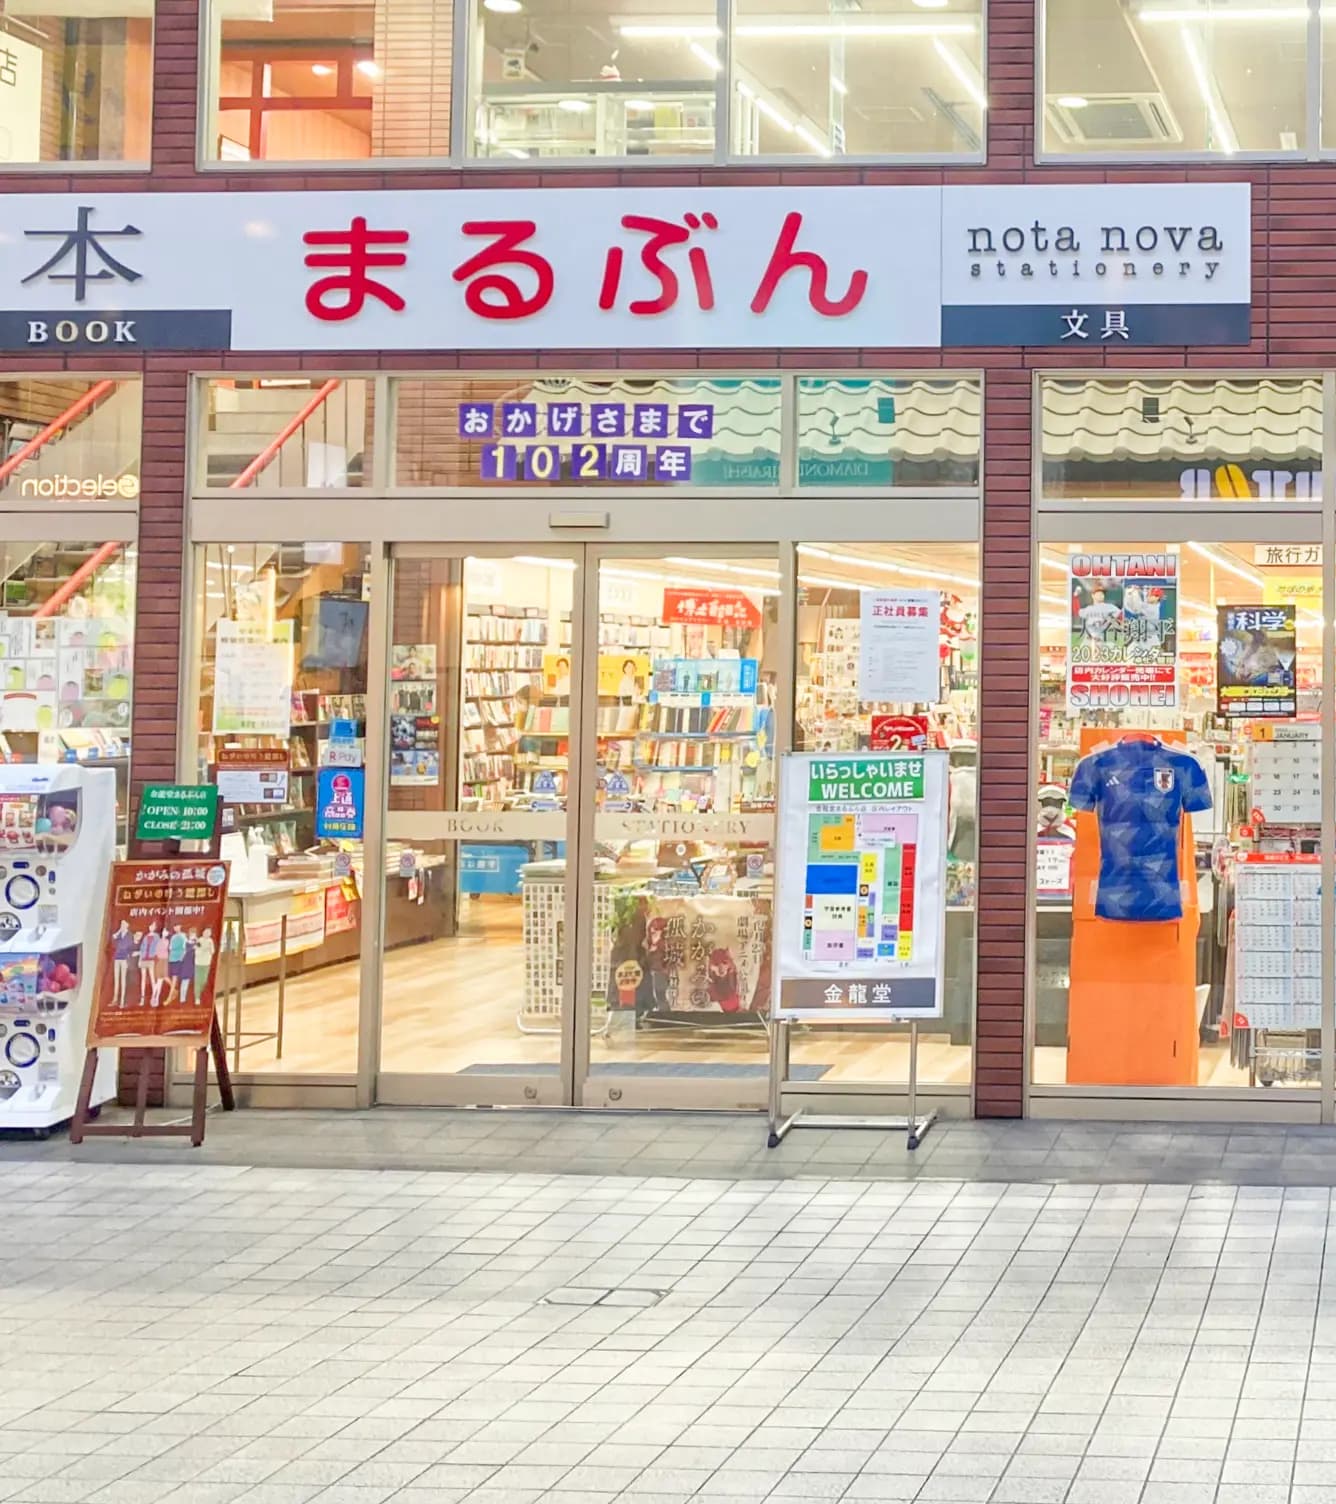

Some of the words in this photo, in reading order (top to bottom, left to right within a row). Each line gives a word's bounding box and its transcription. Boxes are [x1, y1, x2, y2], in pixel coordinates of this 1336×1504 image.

[967, 221, 1080, 254] nota
[1099, 223, 1224, 253] nova
[20, 206, 143, 302] 本
[303, 211, 868, 323] まるぶん
[969, 260, 1222, 280] stationery
[27, 321, 137, 344] BOOK
[1060, 310, 1130, 339] 文具
[463, 407, 711, 435] おかげさまで
[490, 445, 691, 478] 102周年
[1072, 554, 1176, 577] OHTANI
[872, 605, 929, 618] 正社員募集
[1235, 610, 1288, 631] 科学
[1071, 685, 1176, 706] SHOHEI
[811, 761, 922, 780] いらっしゃいませ
[821, 782, 914, 799] WELCOME
[146, 806, 179, 816] OPEN
[144, 821, 177, 830] CLOSE
[622, 819, 751, 833] STATIORY
[823, 983, 892, 1004] 金龍堂
